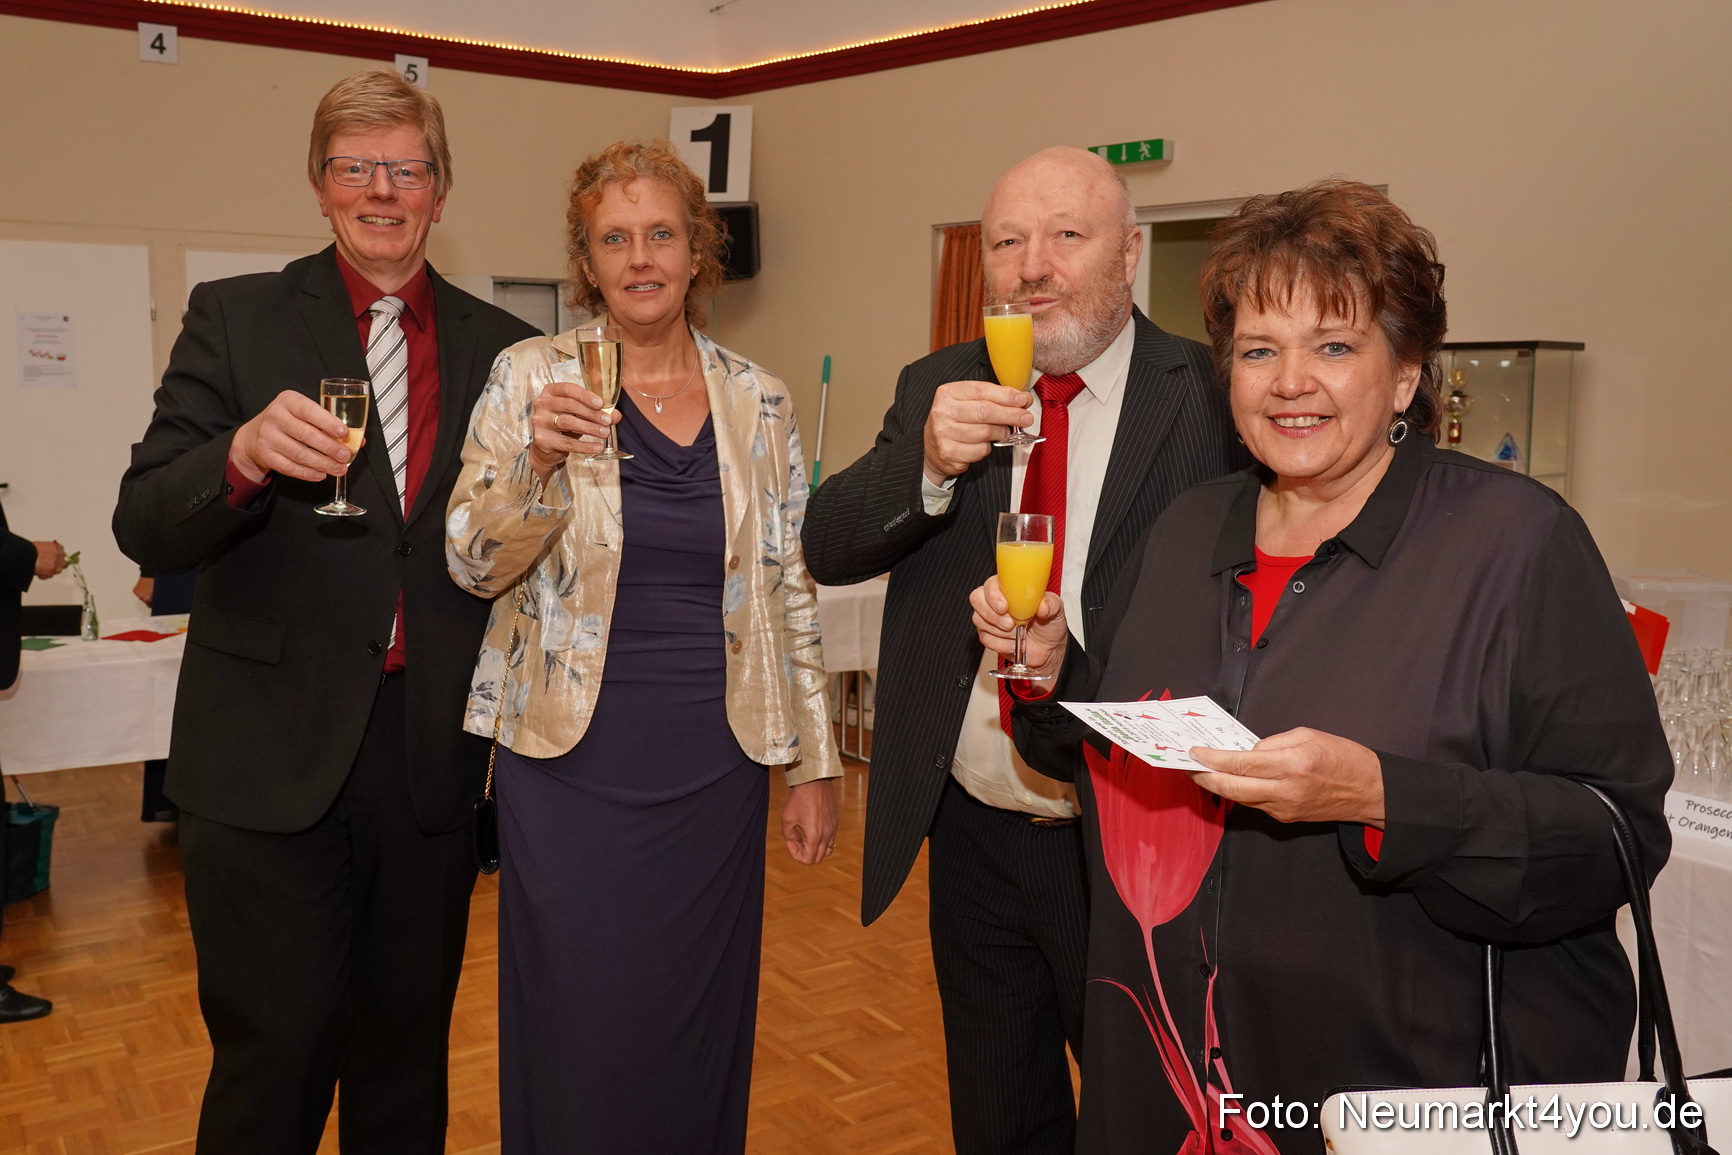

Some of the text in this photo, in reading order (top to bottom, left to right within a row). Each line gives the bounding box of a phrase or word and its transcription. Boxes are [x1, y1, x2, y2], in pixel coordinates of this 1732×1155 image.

[150, 33, 166, 54] 4
[406, 63, 418, 83] 5
[690, 113, 731, 193] 1
